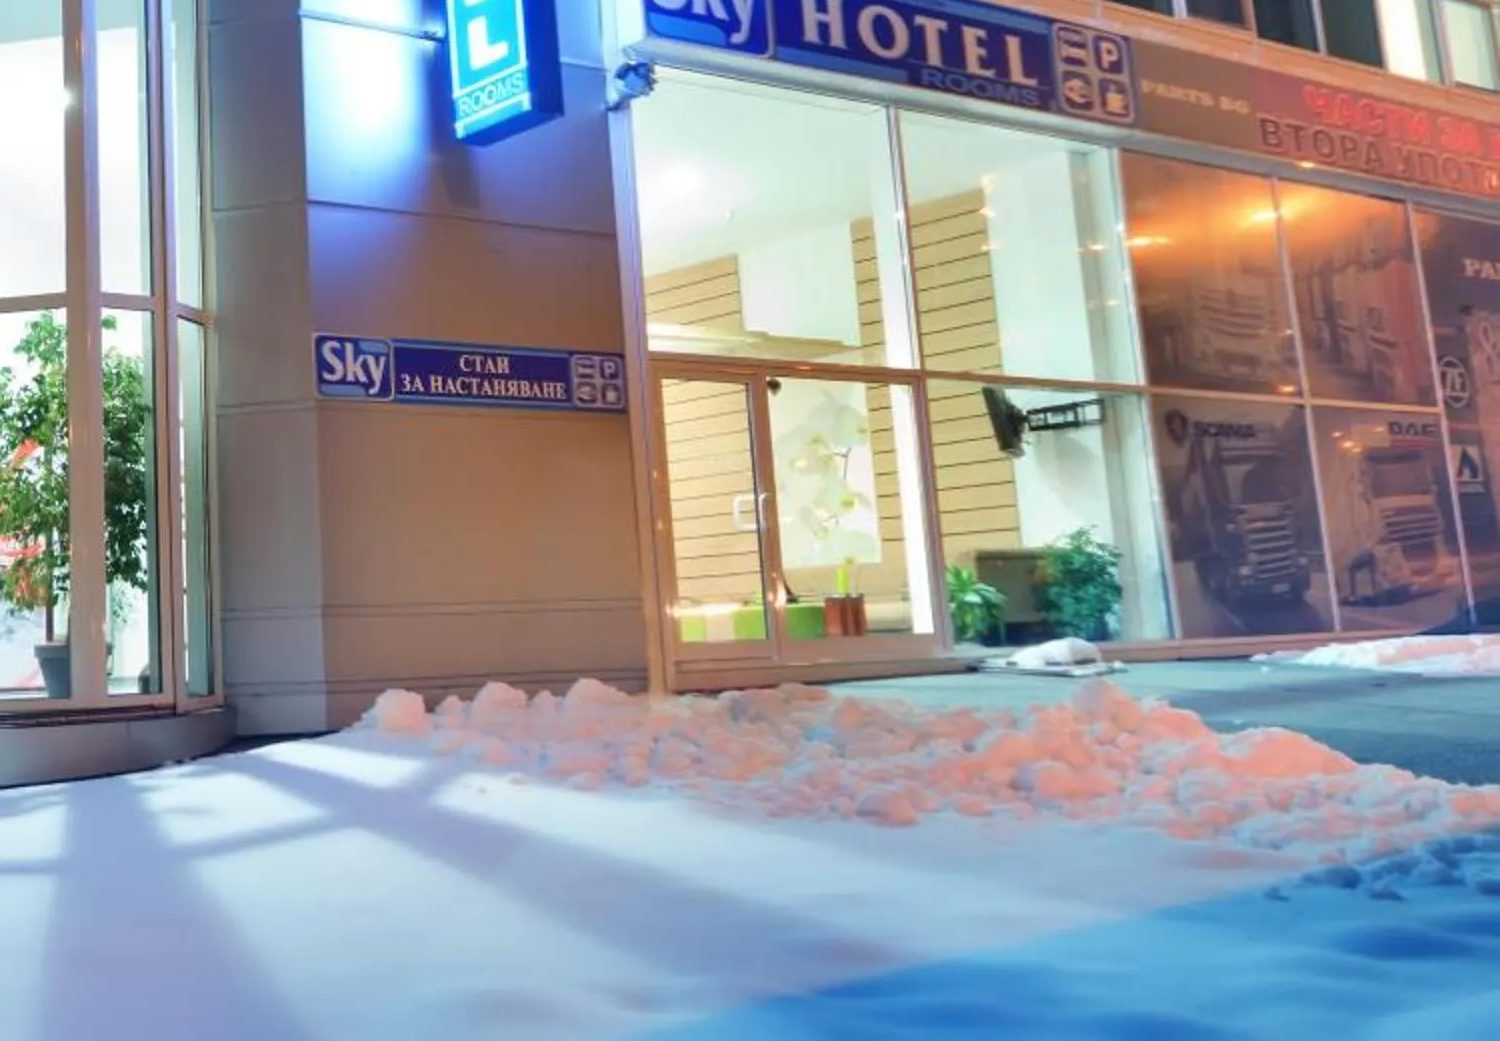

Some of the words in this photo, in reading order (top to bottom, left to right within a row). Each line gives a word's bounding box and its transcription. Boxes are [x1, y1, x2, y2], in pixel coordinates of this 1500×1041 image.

[1100, 39, 1118, 69] P
[459, 70, 525, 117] ROOMS
[921, 67, 1040, 105] ROOMS
[1257, 116, 1384, 173] ВТОРА
[322, 340, 386, 395] Sky
[401, 373, 424, 392] ЗА
